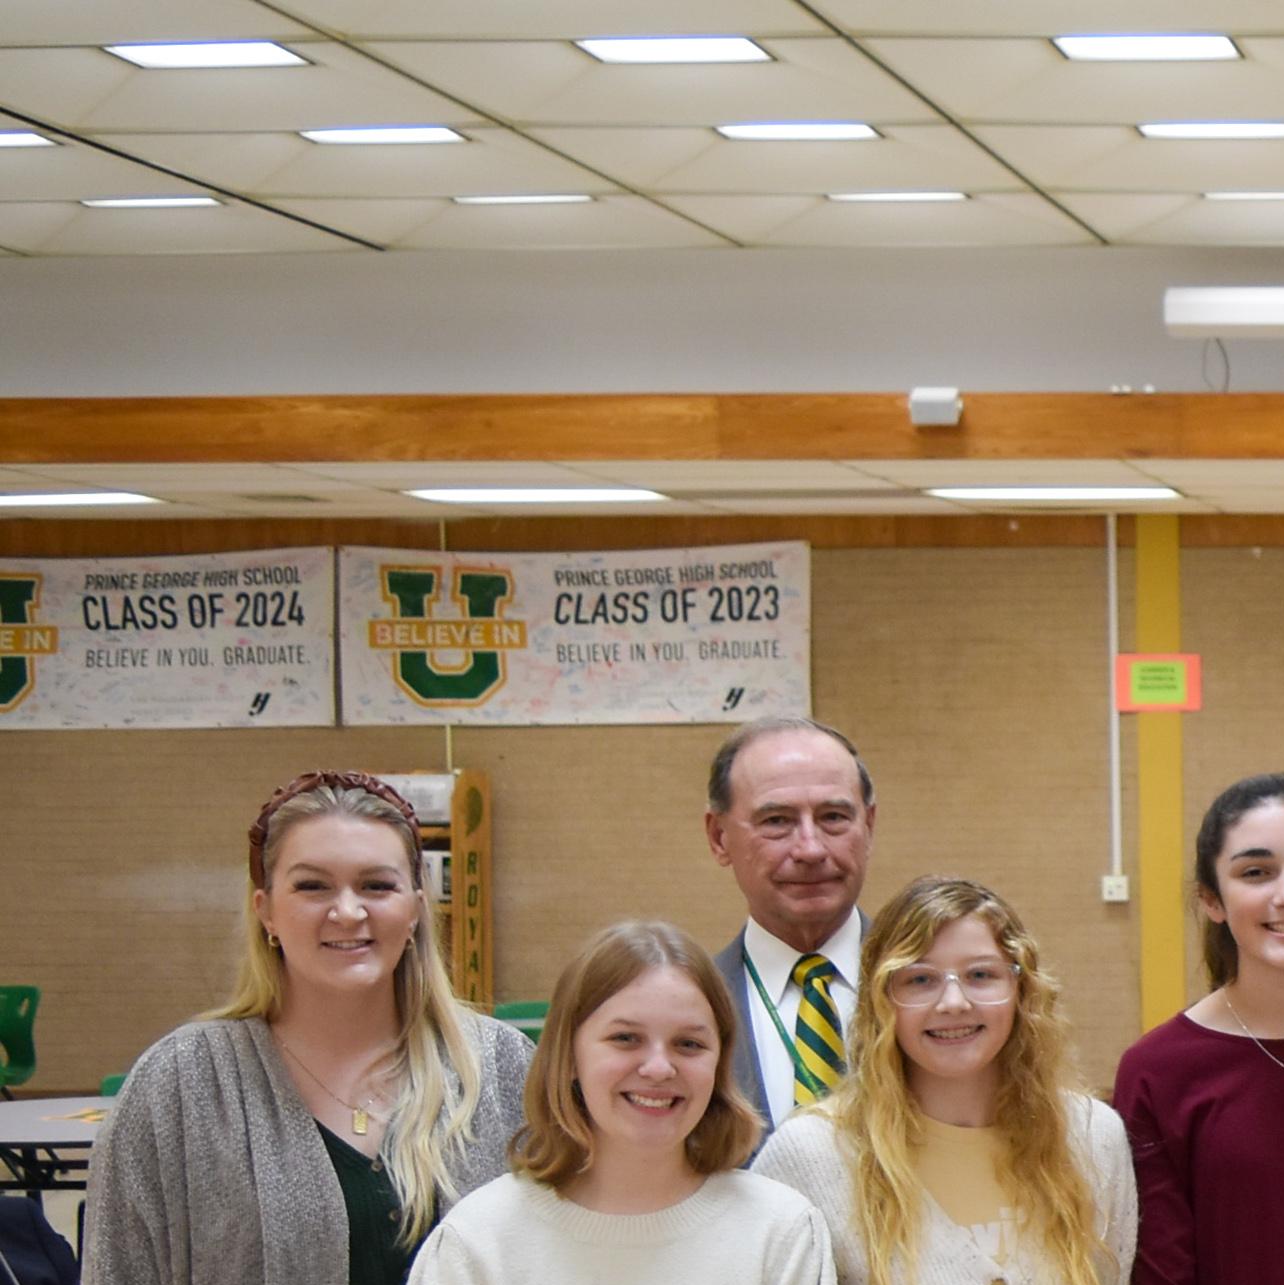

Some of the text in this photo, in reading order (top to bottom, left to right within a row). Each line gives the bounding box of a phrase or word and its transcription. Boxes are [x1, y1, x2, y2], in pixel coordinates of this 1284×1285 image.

[84, 566, 302, 591] PRINCE GEORGE HIGH SCHOOL
[554, 560, 778, 587] PRINCE GEORGE HIGH SCHOOL
[82, 591, 305, 631] CLASS OF 2024
[554, 585, 780, 625] CLASS OF 2023
[375, 623, 521, 645] BELIEVE IN
[85, 645, 311, 668] BELIEVE IN YOU. GRADUATE.
[557, 640, 787, 664] BELIEVE IN YOU. GRADUATE.
